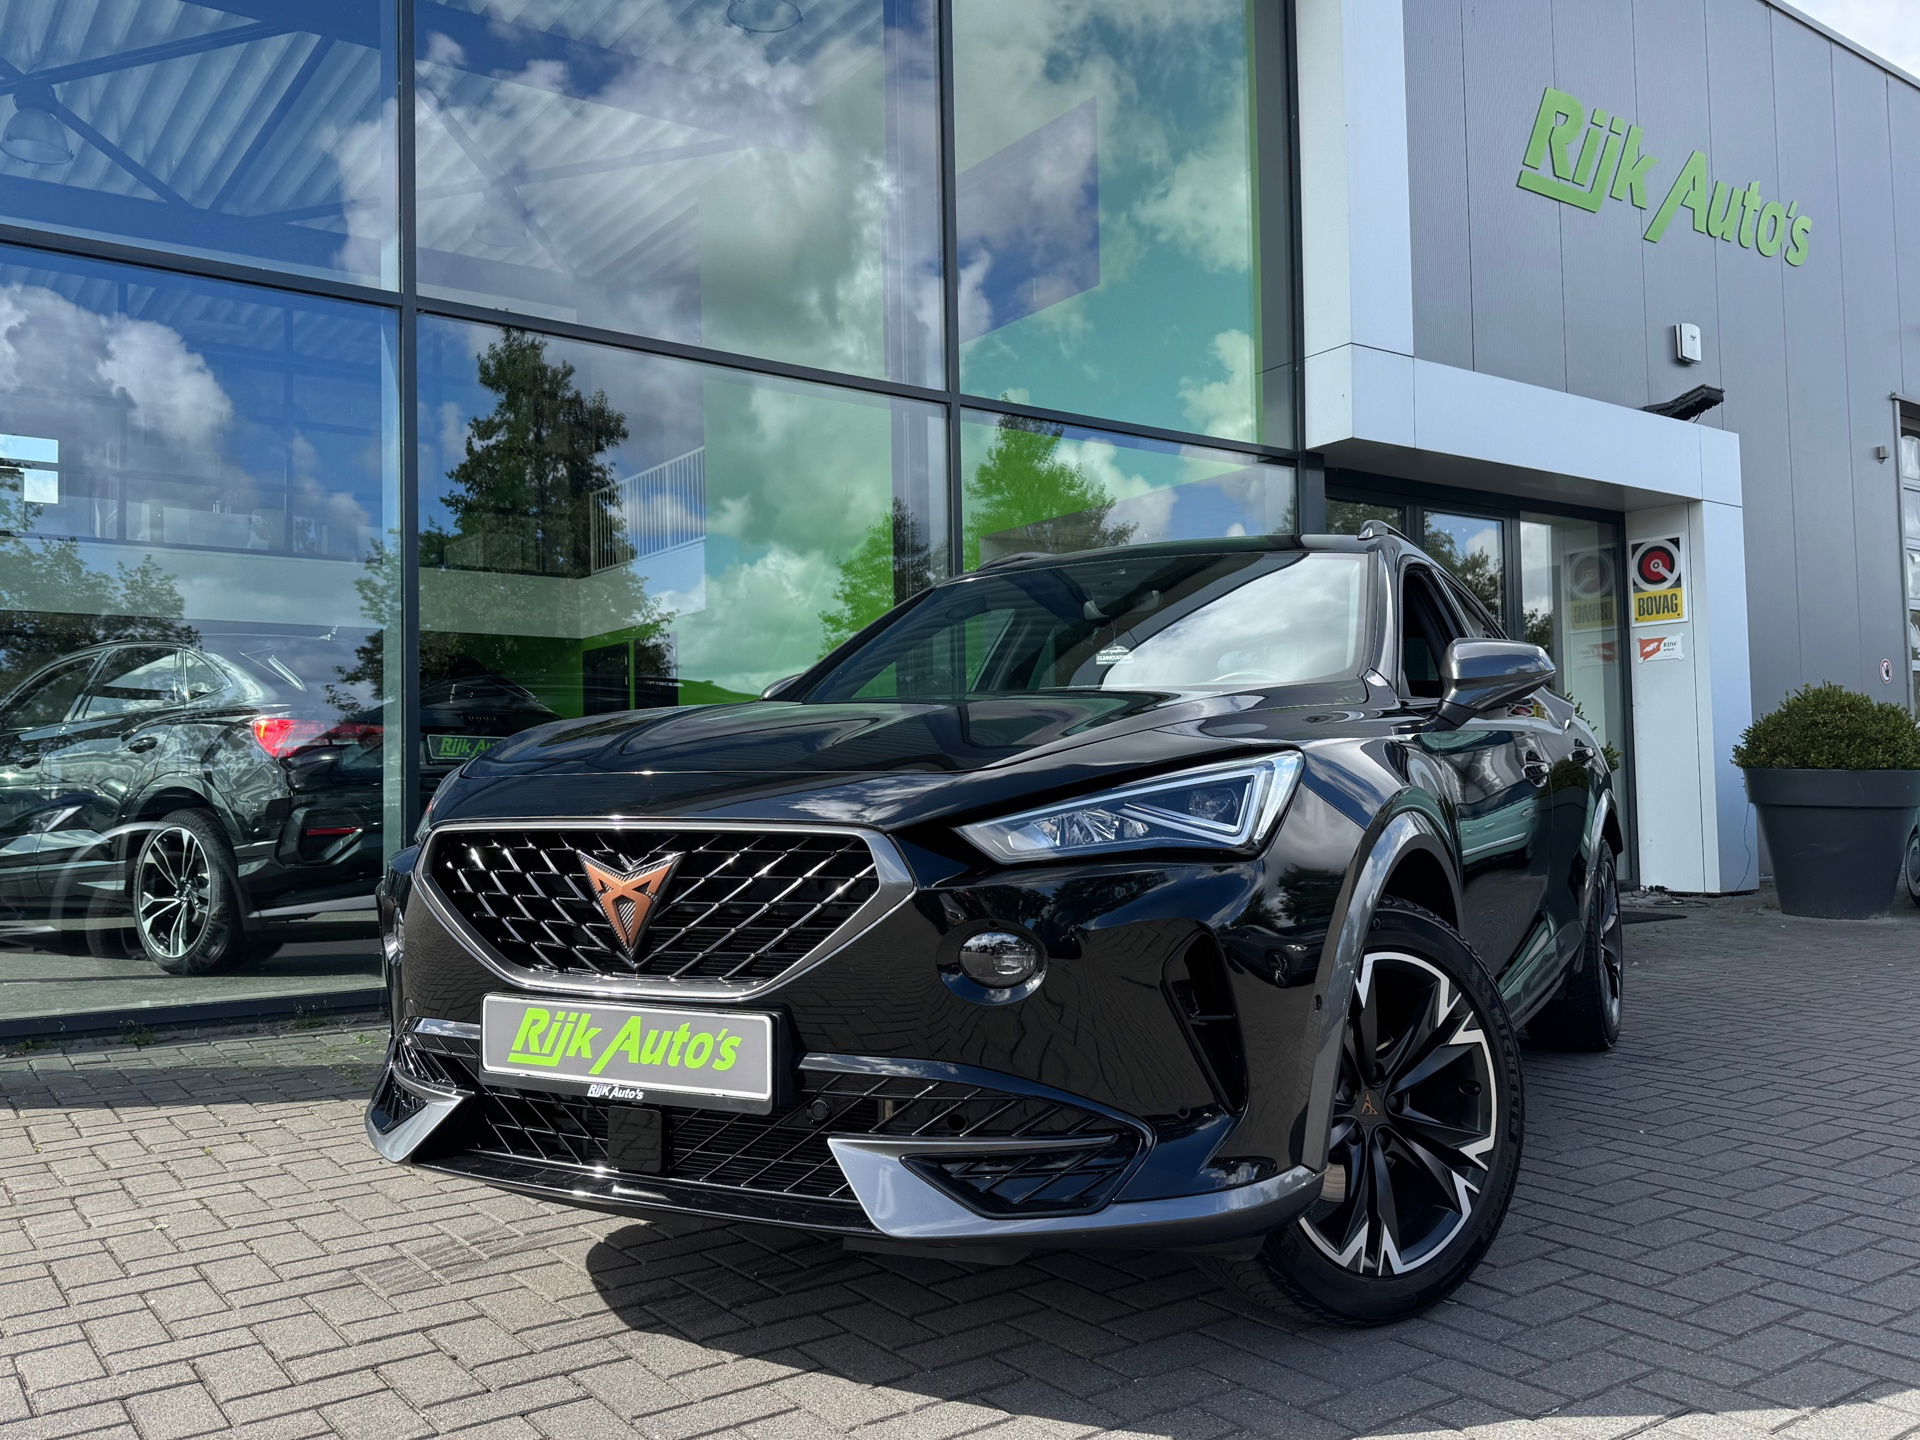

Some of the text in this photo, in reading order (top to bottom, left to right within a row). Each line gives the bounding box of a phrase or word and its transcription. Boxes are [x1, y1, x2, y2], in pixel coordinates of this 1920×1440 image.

[1516, 86, 1813, 267] Rijk Auto's
[1637, 592, 1679, 617] BOVAG
[507, 1007, 742, 1075] Rijk Auto's
[608, 1086, 645, 1100] Auto's
